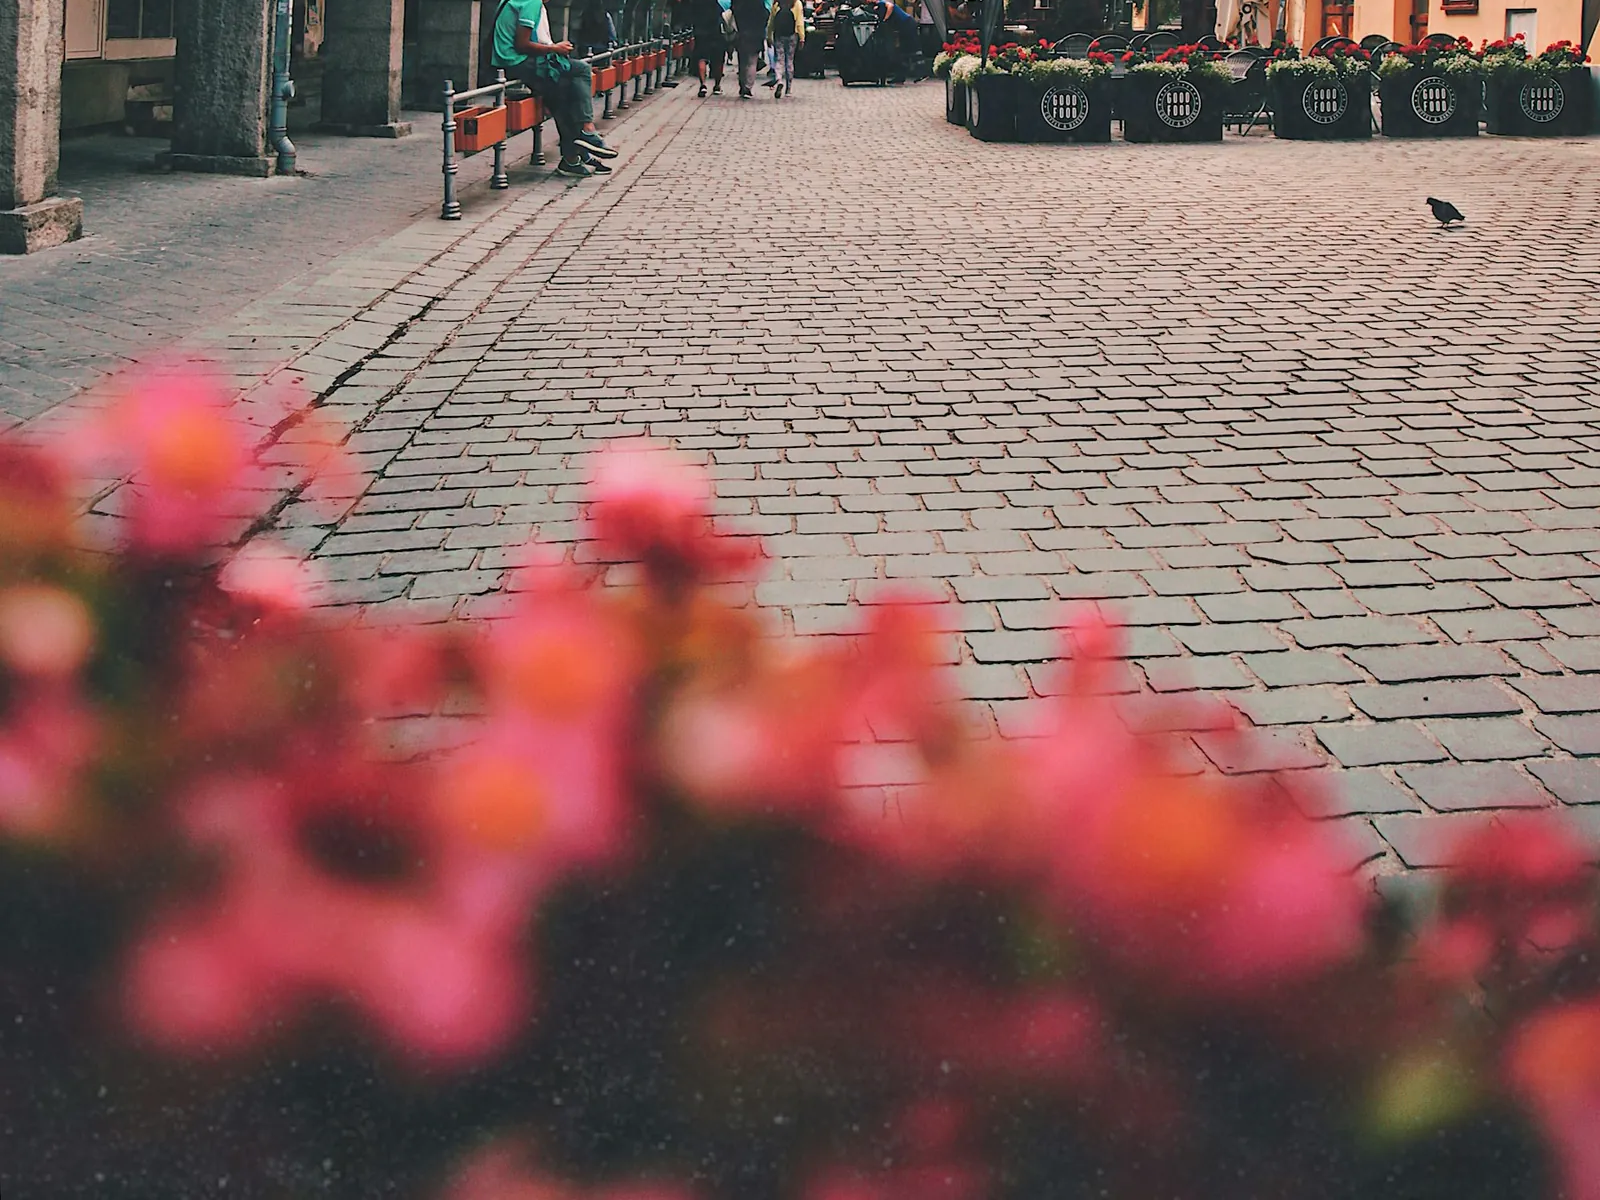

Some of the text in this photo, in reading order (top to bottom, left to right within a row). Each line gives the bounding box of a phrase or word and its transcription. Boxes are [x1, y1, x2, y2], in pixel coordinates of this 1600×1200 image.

[1053, 94, 1077, 106] GOOD
[1166, 91, 1191, 104] GOOD
[1313, 88, 1337, 100] GOOD
[1422, 88, 1447, 100] GOOD
[1167, 104, 1190, 116] FOOD
[1314, 101, 1337, 112] FOOD
[1423, 100, 1447, 112] FOOD
[1053, 107, 1077, 119] FOOD
